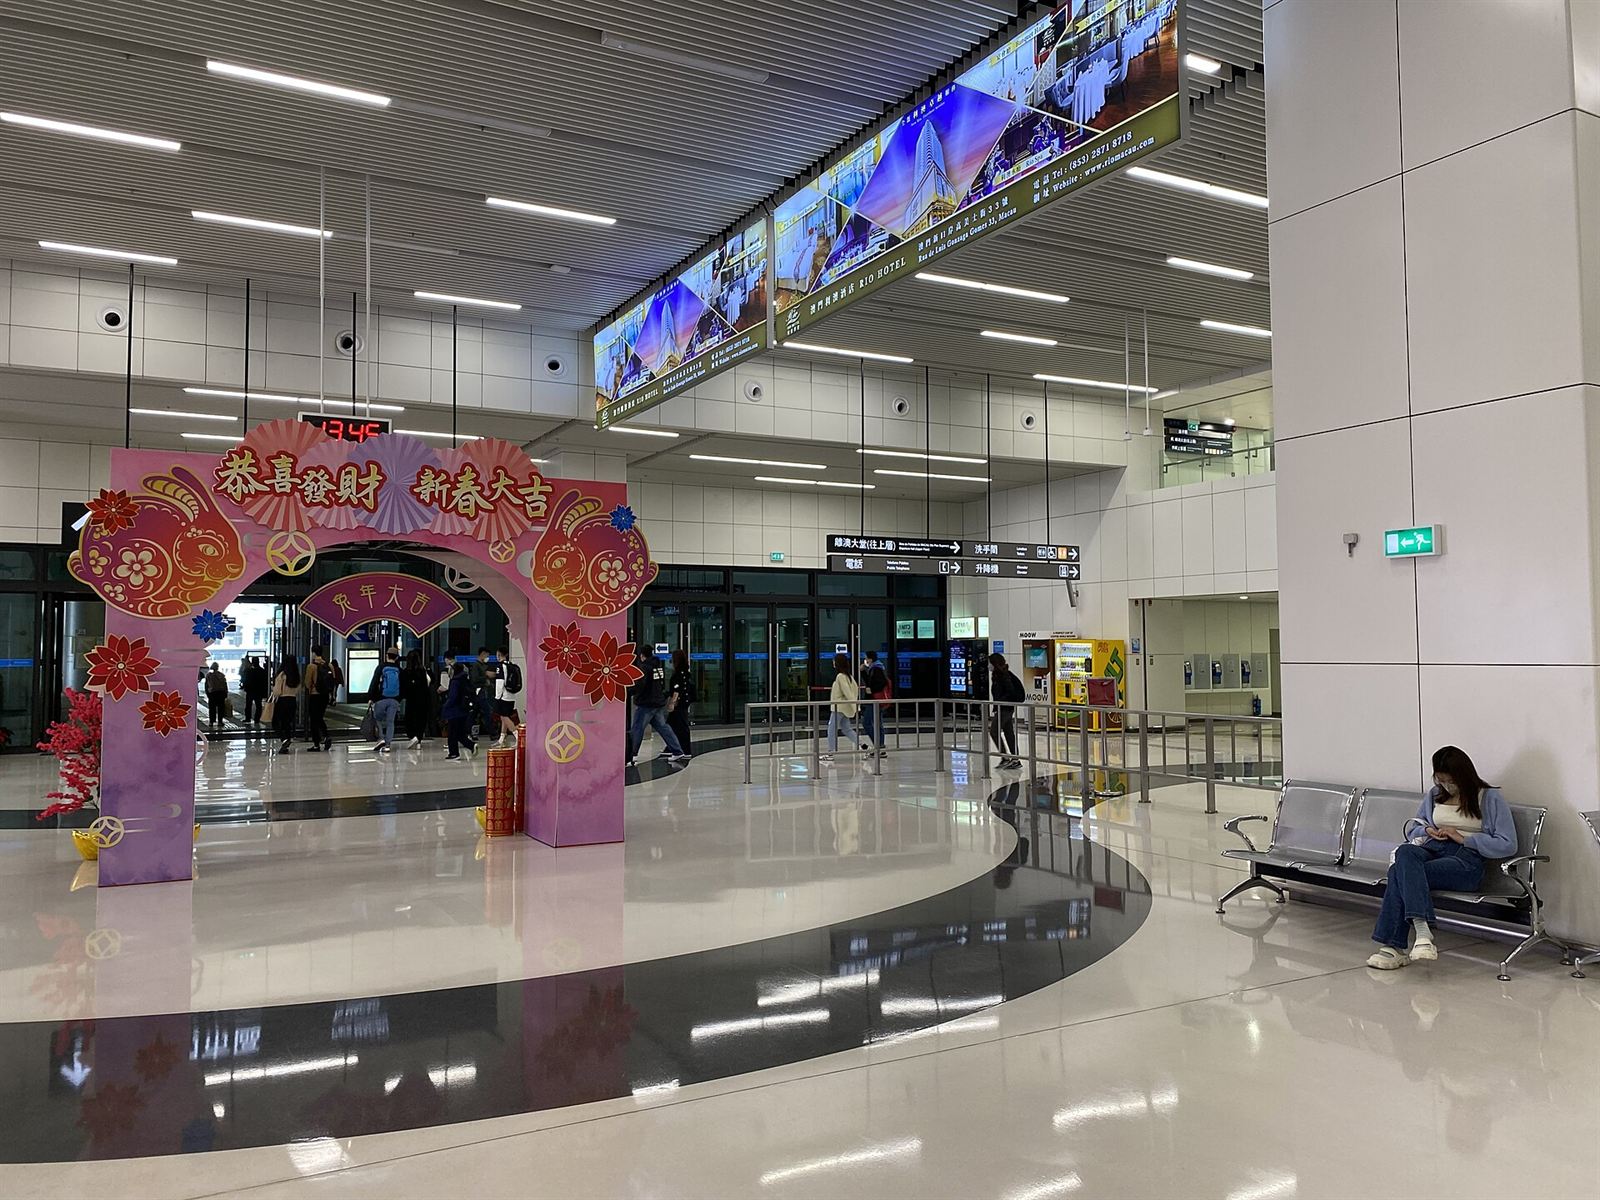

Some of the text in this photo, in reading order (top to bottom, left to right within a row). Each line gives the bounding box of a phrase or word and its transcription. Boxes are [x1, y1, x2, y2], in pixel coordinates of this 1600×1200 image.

[1069, 154, 1089, 171] (853)
[1091, 142, 1110, 160] 2871
[1112, 131, 1133, 149] 8718
[1084, 136, 1155, 177] www.riomacau.com
[918, 252, 928, 263] Rua
[928, 249, 935, 258] de
[969, 224, 988, 236] Gomes
[998, 207, 1017, 221] Macau
[859, 274, 875, 289] RIO
[877, 256, 907, 280] HOTEL
[216, 449, 553, 518] 恭喜發財 新春大吉
[845, 558, 863, 570] 電話
[975, 544, 998, 555] 洗手間
[975, 563, 999, 574] 升降機
[1026, 693, 1049, 702] MOOW
